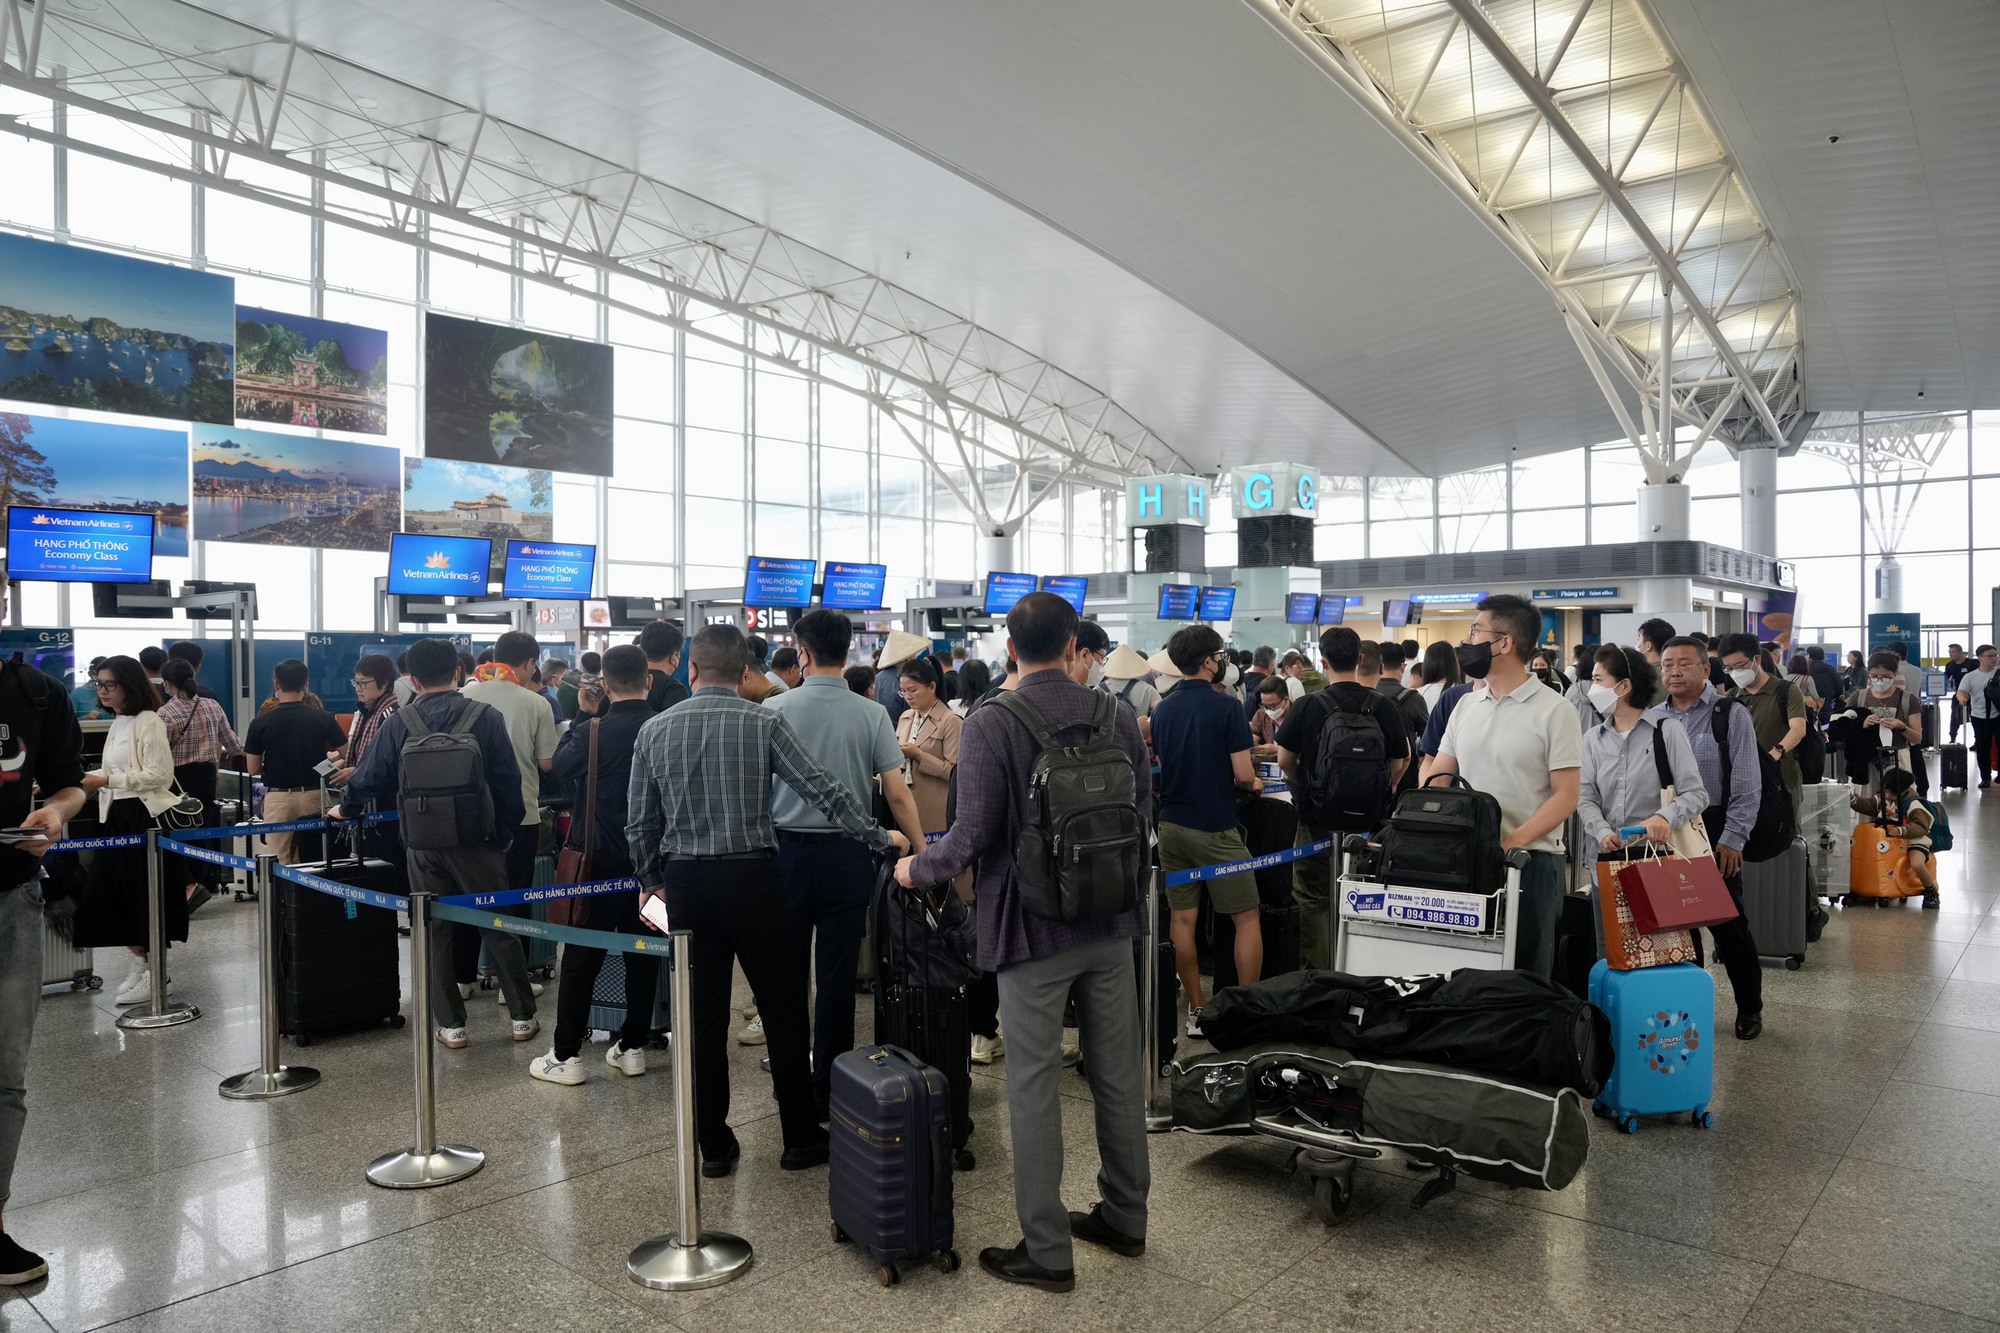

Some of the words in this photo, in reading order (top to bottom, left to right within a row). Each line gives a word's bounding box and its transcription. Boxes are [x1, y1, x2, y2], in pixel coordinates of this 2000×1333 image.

[1243, 473, 1274, 511] G
[1297, 473, 1315, 511] G
[1139, 483, 1163, 518] H
[1187, 484, 1205, 518] H
[50, 517, 88, 527] Vietnam
[88, 519, 120, 529] Airlines
[34, 539, 66, 549] HẠNG
[94, 540, 129, 551] THÔNG
[45, 550, 92, 562] Economy
[93, 551, 118, 561] Class
[403, 569, 438, 579] Vietnam
[438, 570, 469, 580] Airlines
[527, 573, 555, 583] Economy
[556, 574, 572, 582] Class
[761, 584, 784, 593] Economy
[1560, 590, 1578, 598] Phòng
[39, 632, 69, 642] G-12
[309, 636, 332, 645] G-11
[449, 637, 469, 645] G-10
[59, 840, 84, 850] KHÔNG
[85, 838, 104, 848] QUỐC
[115, 838, 128, 849] NỘI
[129, 835, 141, 845] BÀI
[1190, 870, 1201, 879] N.I.A
[1215, 865, 1227, 875] CẢNG
[1226, 863, 1238, 874] HÀNG
[1238, 860, 1252, 871] KHÔNG
[1252, 857, 1263, 869] QUỐC
[1293, 848, 1303, 857] N.I.A
[333, 885, 345, 896] QUỐC
[375, 894, 386, 904] N.I.A
[475, 895, 496, 905] N.I.A
[523, 889, 544, 901] CẢNG
[545, 887, 566, 898] HÀNG
[567, 884, 592, 896] KHÔNG
[593, 880, 613, 892] QUỐC
[613, 878, 623, 889] TẾ
[623, 878, 636, 890] NỘI
[1387, 893, 1413, 901] BIZMAN
[1421, 896, 1446, 909] 20.000
[1406, 908, 1476, 926] 094.986.98.98
[502, 920, 523, 930] Vietnam
[523, 924, 542, 934] Airlines
[1658, 1034, 1682, 1045] Almond
